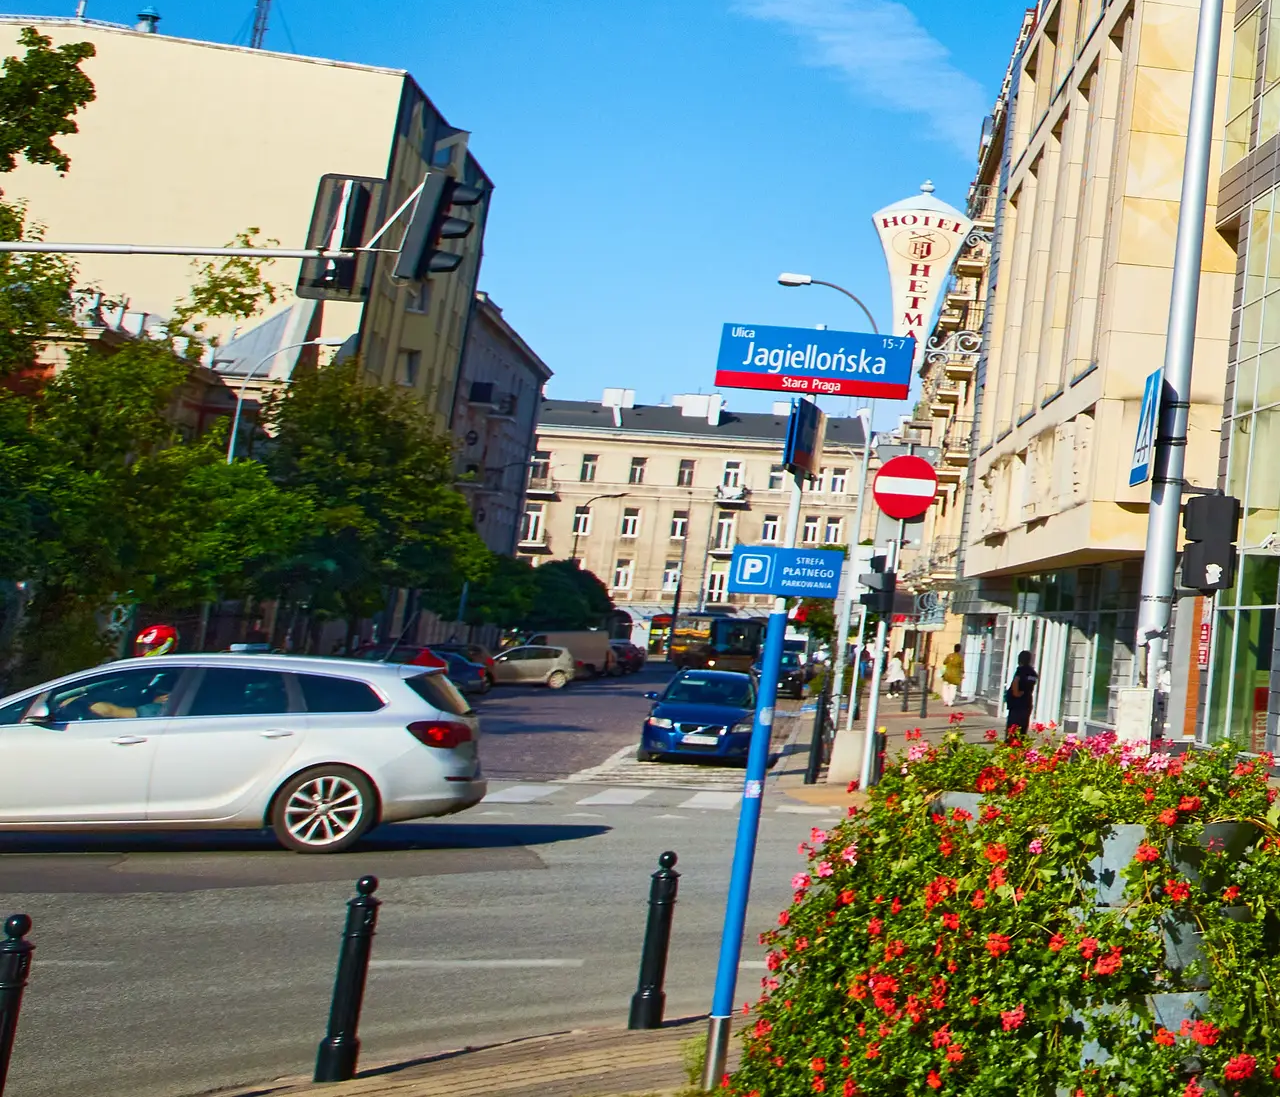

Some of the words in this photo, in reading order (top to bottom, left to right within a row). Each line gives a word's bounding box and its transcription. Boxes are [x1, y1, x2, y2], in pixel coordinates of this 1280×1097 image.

[882, 215, 965, 235] HOTEL
[902, 263, 931, 360] HETMA
[731, 326, 756, 339] Ulica
[882, 338, 906, 350] 15-7
[742, 341, 888, 375] Jagiellońska
[782, 376, 808, 389] Stara
[812, 378, 841, 393] Praga
[796, 556, 825, 566] STREFA
[742, 558, 763, 580] P
[782, 567, 835, 579] PŁATNEGO
[781, 579, 832, 589] PARKOWANIA
